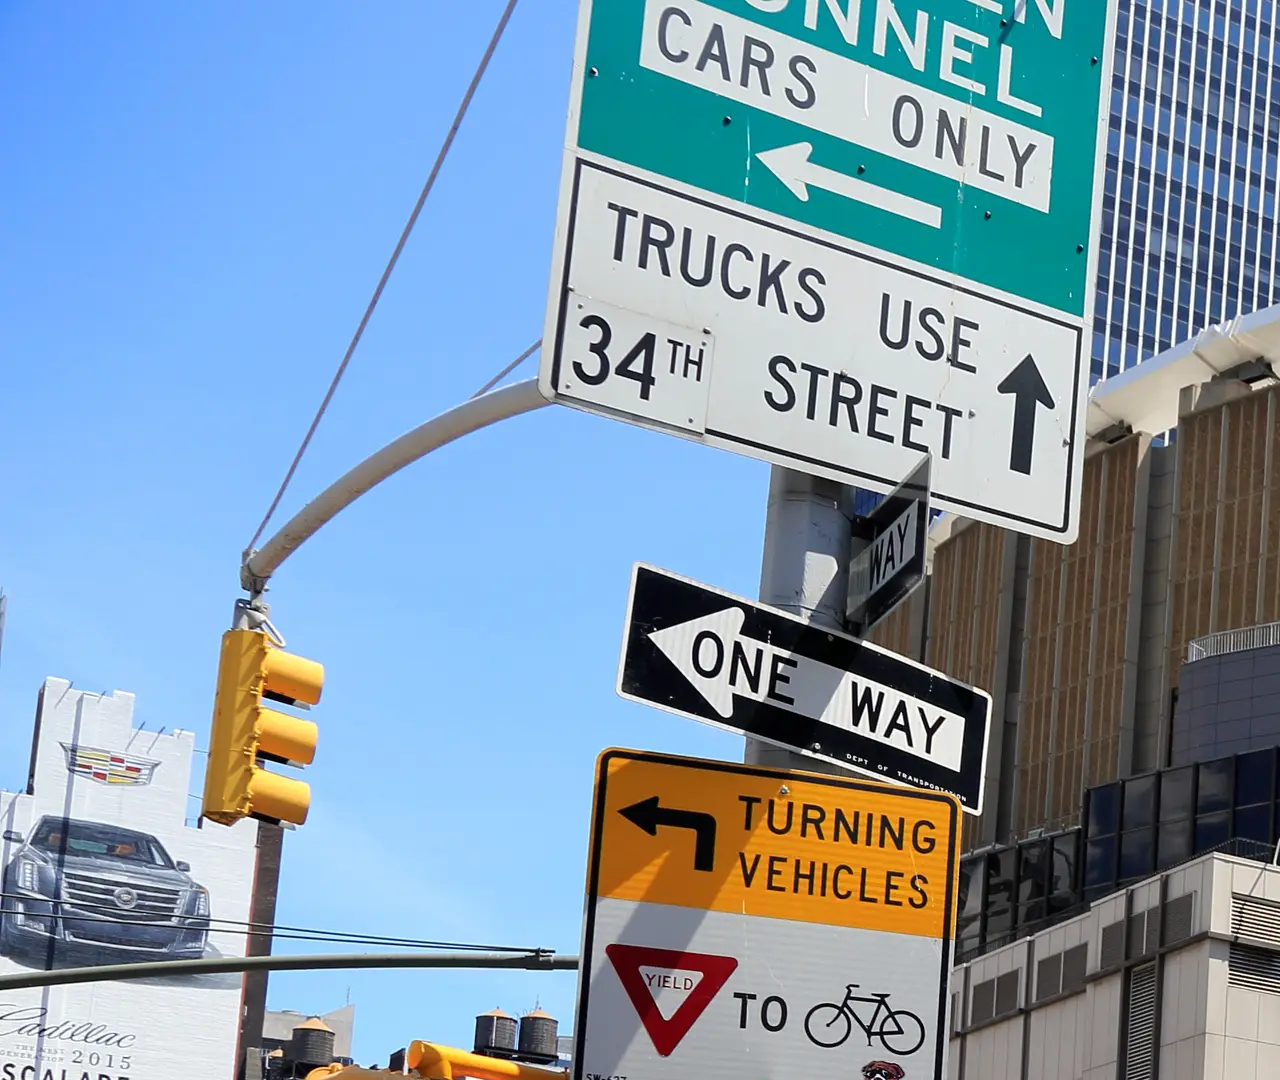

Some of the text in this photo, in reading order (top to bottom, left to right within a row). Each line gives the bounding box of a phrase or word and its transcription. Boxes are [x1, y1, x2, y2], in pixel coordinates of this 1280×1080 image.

[752, 0, 1042, 118] NNEL
[657, 6, 1038, 188] CARS ONLY
[607, 202, 979, 374] TRUCKS USE
[572, 314, 963, 460] 34TH STREET
[867, 513, 911, 591] WAY
[692, 630, 947, 755] ONE WAY
[846, 753, 869, 766] DEPT
[877, 764, 889, 772] OF
[738, 795, 936, 855] TURNING
[738, 852, 929, 909] VEHICLES
[645, 973, 695, 992] YIELD
[732, 992, 788, 1033] TO
[72, 1049, 132, 1070] 2015
